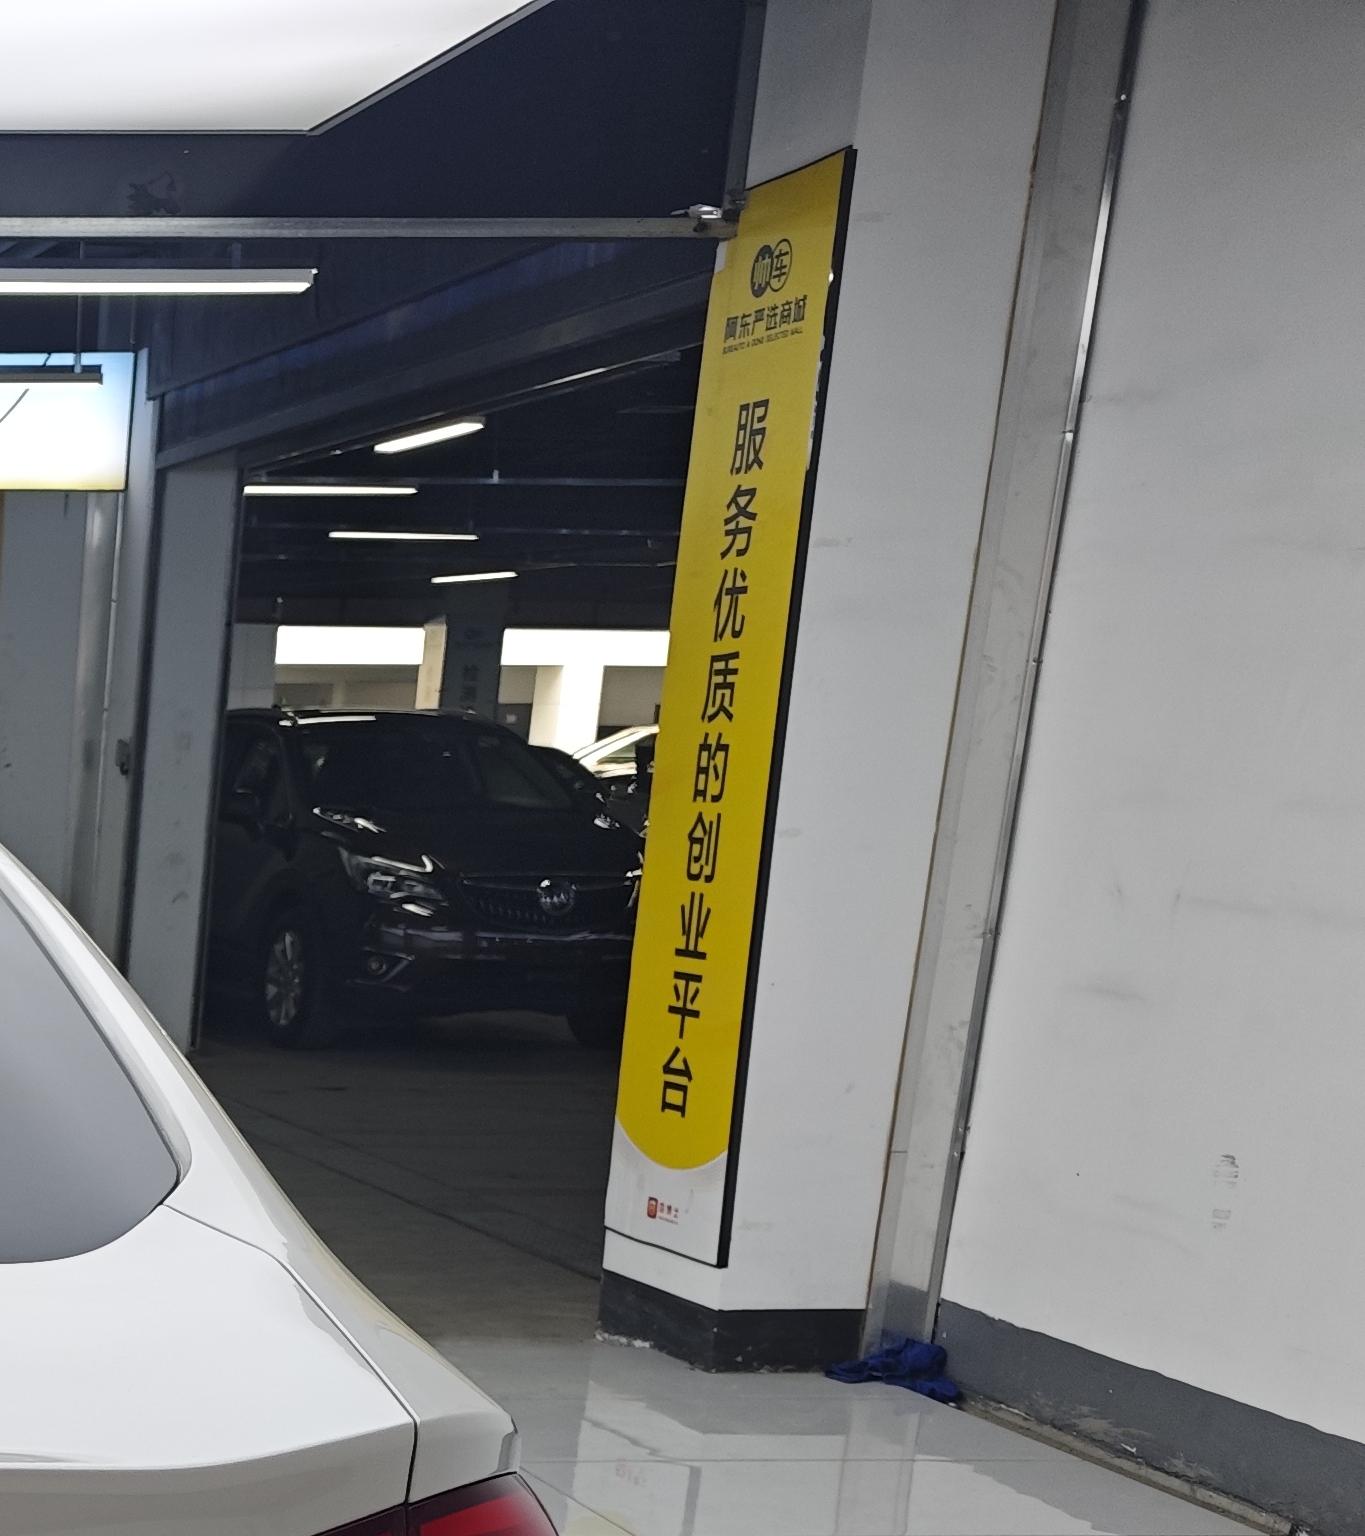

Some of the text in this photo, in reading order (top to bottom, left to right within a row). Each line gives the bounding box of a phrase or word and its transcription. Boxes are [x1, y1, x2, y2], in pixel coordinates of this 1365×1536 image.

[723, 295, 808, 343] 阿东严选商城
[659, 398, 771, 1119] 服务优质的创业平台
